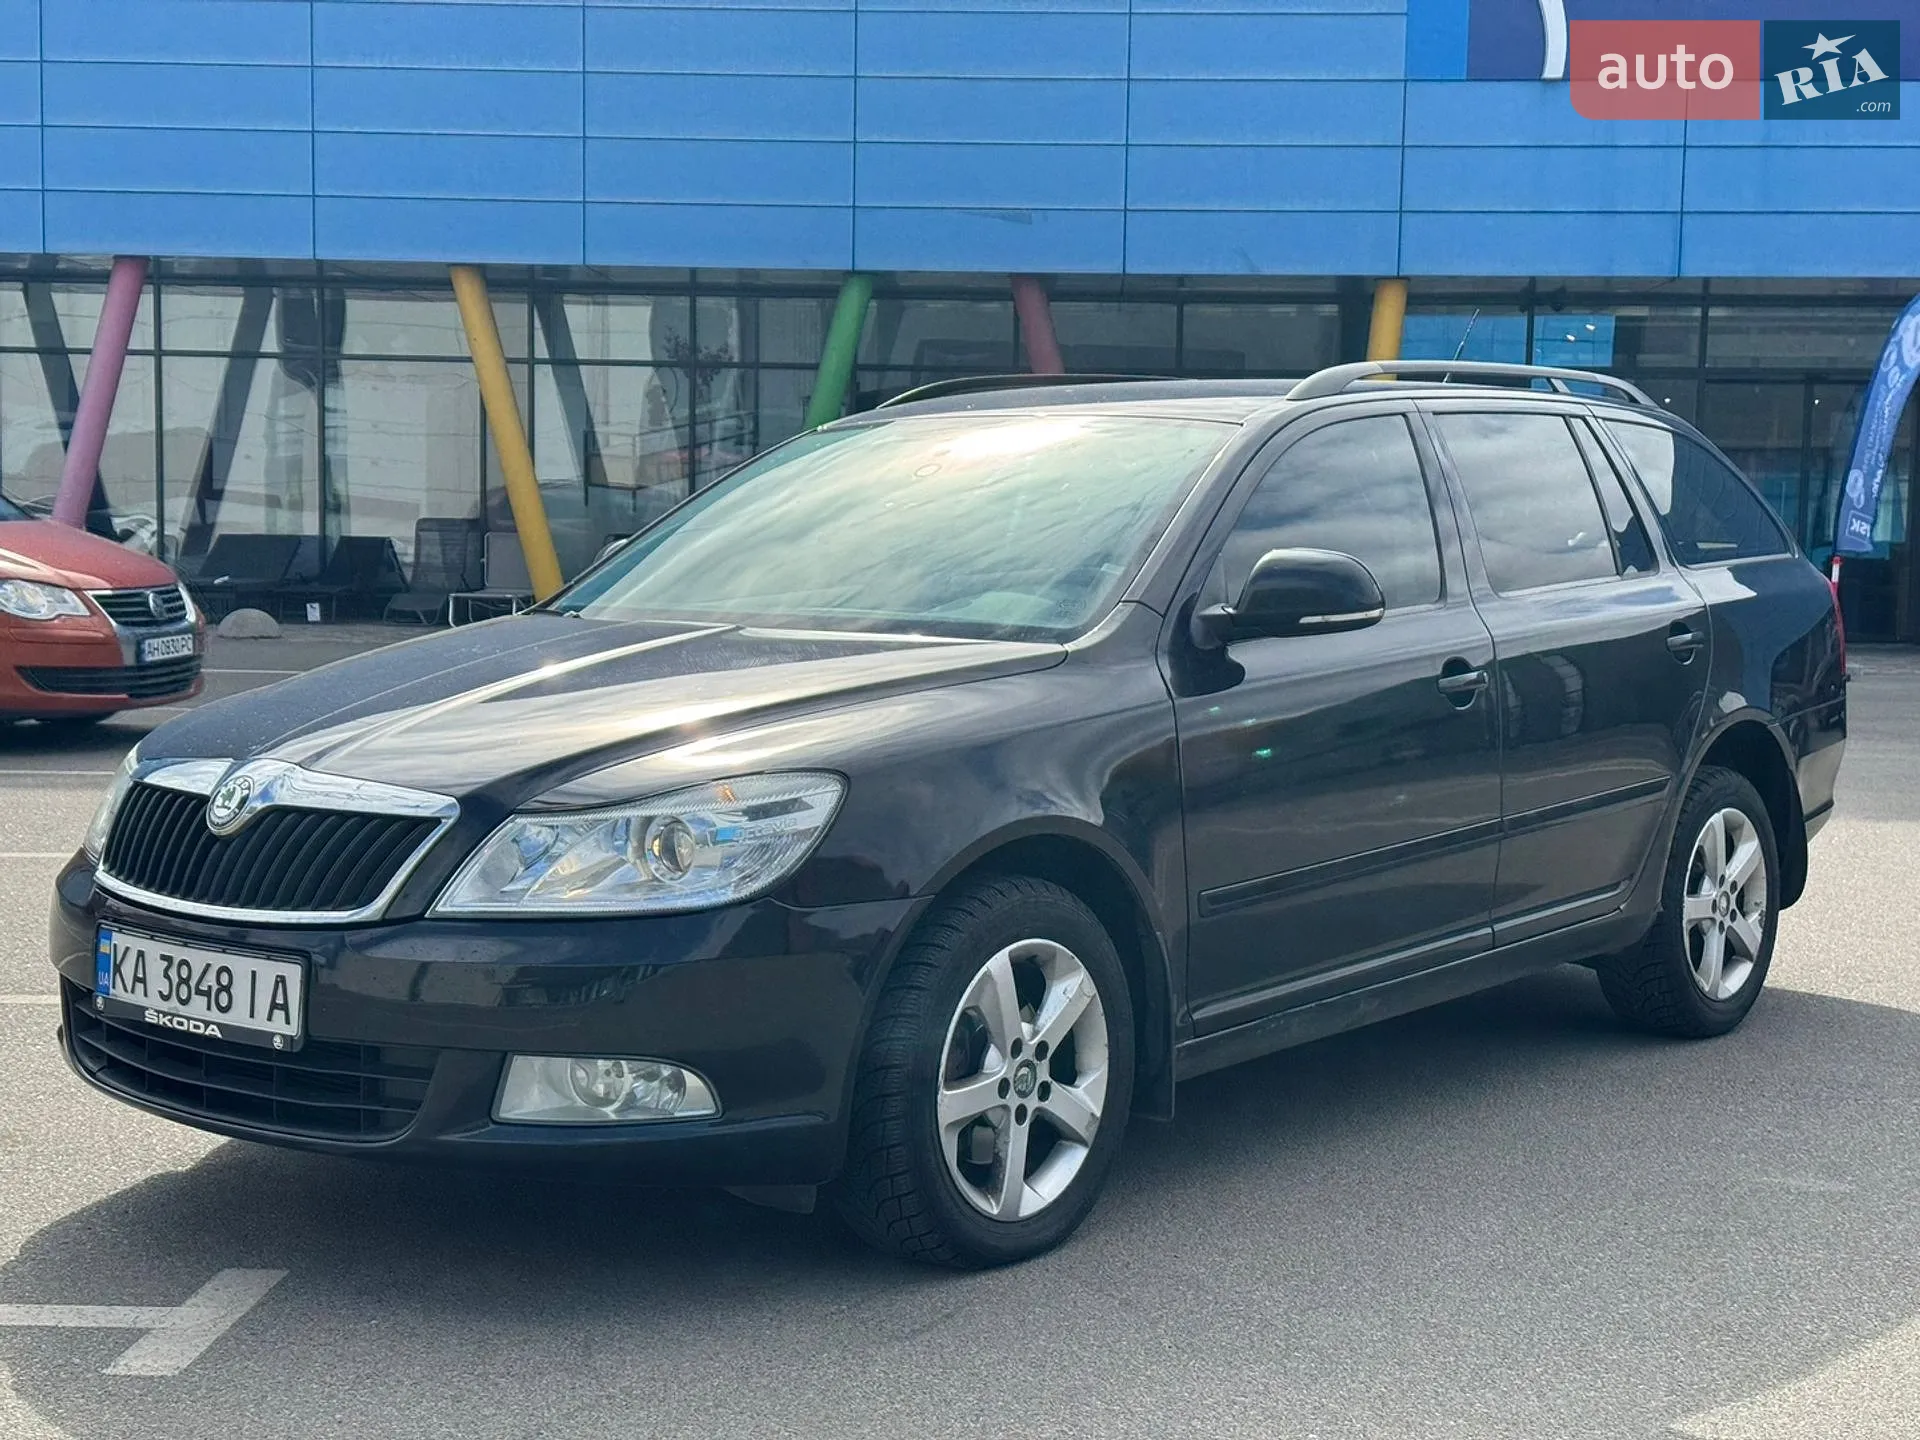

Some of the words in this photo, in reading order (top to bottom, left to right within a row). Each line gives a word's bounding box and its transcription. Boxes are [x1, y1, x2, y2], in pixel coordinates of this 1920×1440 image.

[98, 971, 110, 987] UA
[111, 943, 148, 998] KA
[157, 953, 234, 1014] 3848
[249, 968, 291, 1025] IA
[144, 1008, 223, 1039] ŠKODA
